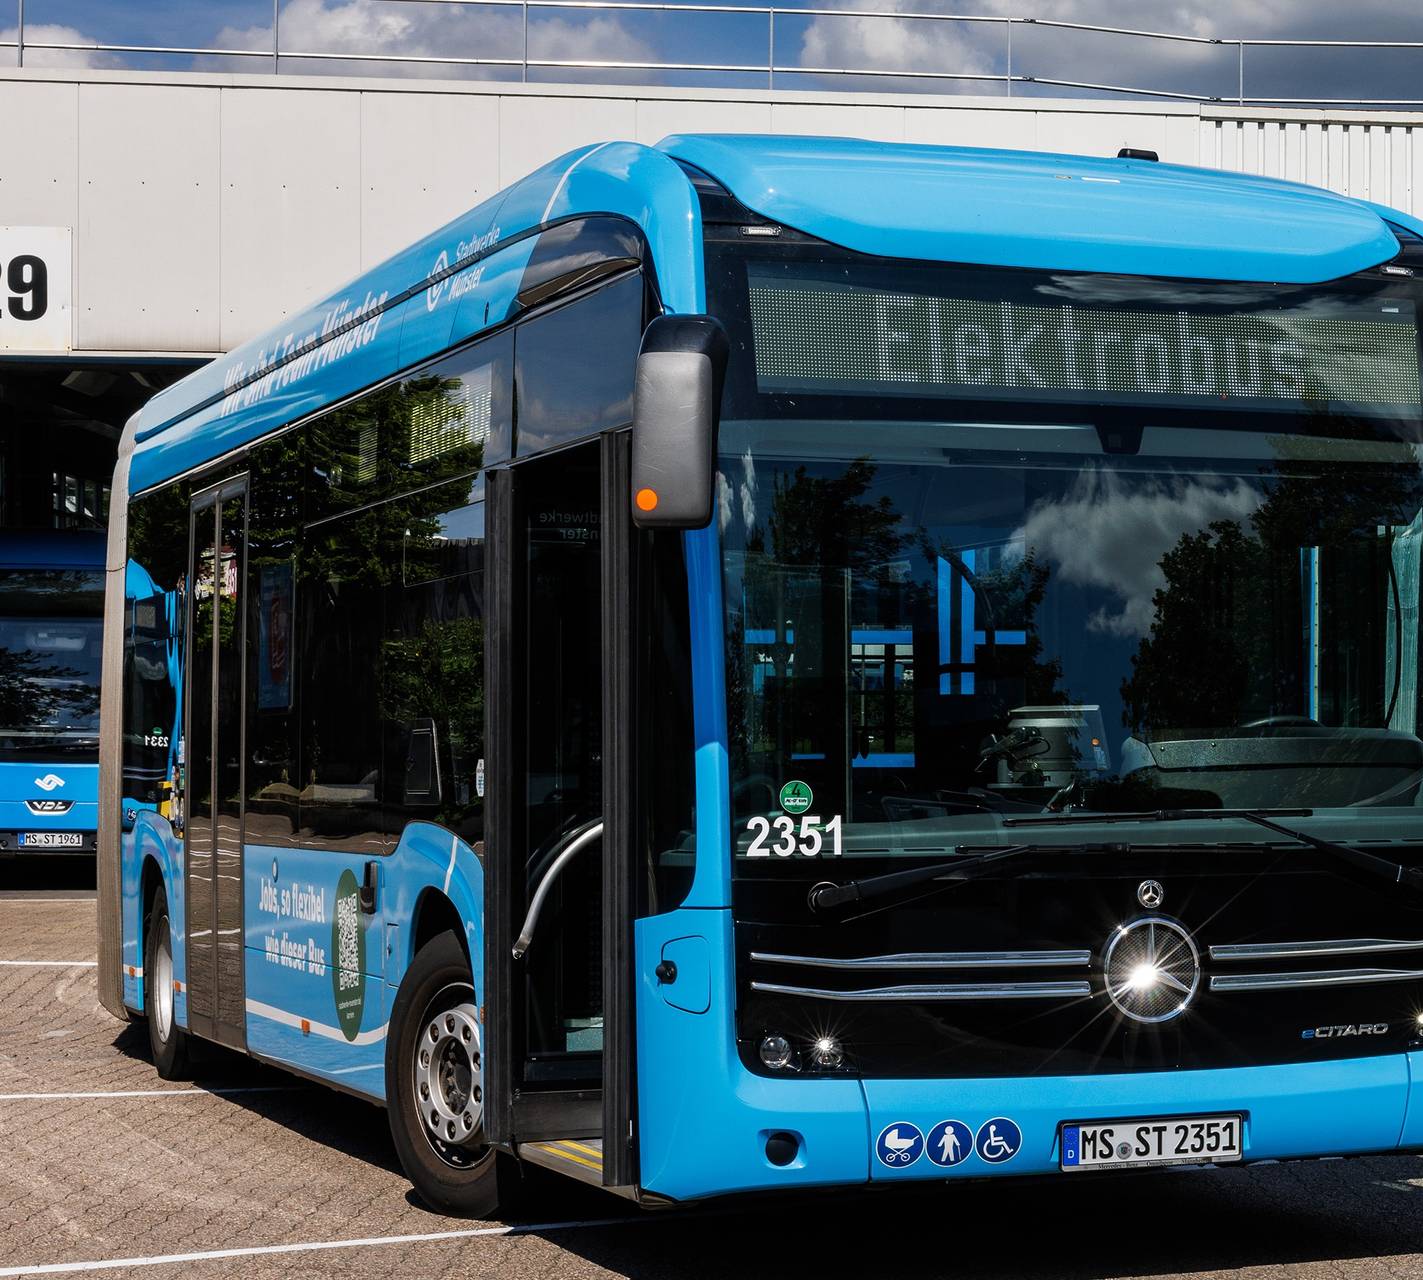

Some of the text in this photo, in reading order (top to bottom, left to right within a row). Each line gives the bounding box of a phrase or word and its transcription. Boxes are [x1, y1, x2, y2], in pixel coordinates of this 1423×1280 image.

[457, 223, 500, 264] Stadtwerke
[0, 254, 48, 321] 9
[448, 266, 485, 301] Münster
[221, 291, 388, 418] Wir sind Team Münster
[876, 294, 1303, 399] Elektrobus
[33, 801, 66, 810] VDL
[25, 834, 81, 844] MS ST 1961
[746, 815, 842, 857] 2351
[259, 878, 325, 923] Jobs, so flexibel
[265, 929, 325, 976] wie dieser Bus
[1301, 1022, 1389, 1039] eCITARO
[1067, 1149, 1075, 1159] D
[1081, 1121, 1236, 1160] MS ST 2351
